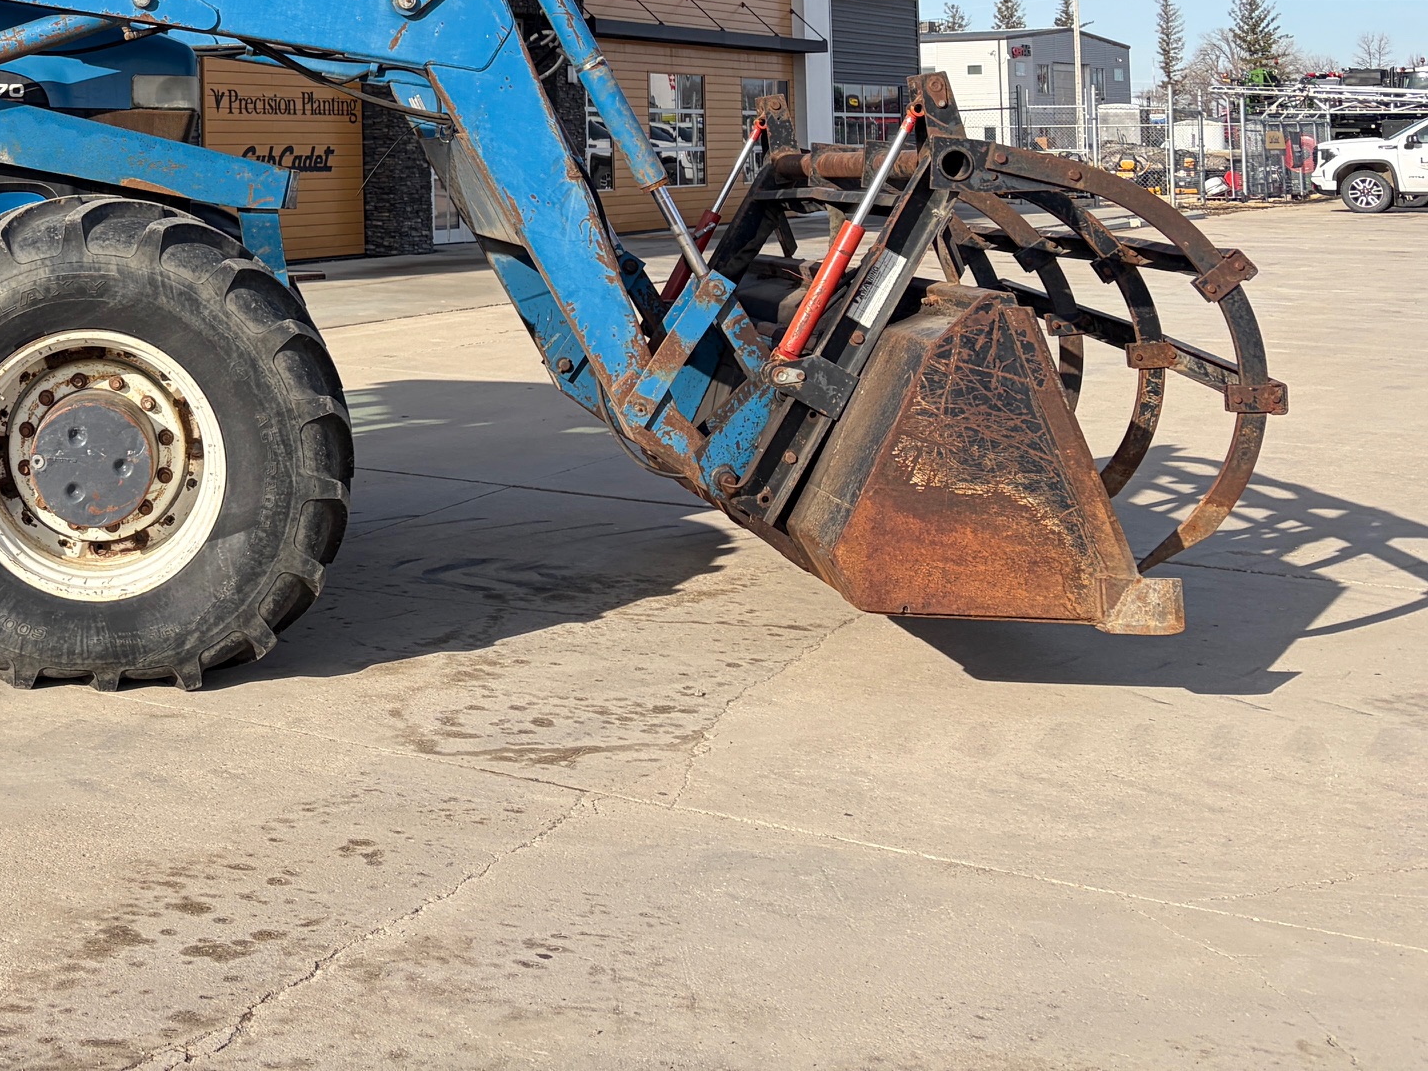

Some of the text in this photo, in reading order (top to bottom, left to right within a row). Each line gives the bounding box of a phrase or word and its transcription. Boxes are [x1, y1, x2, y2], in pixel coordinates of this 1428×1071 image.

[227, 89, 358, 124] Precision Planting
[278, 146, 335, 171] Cadet
